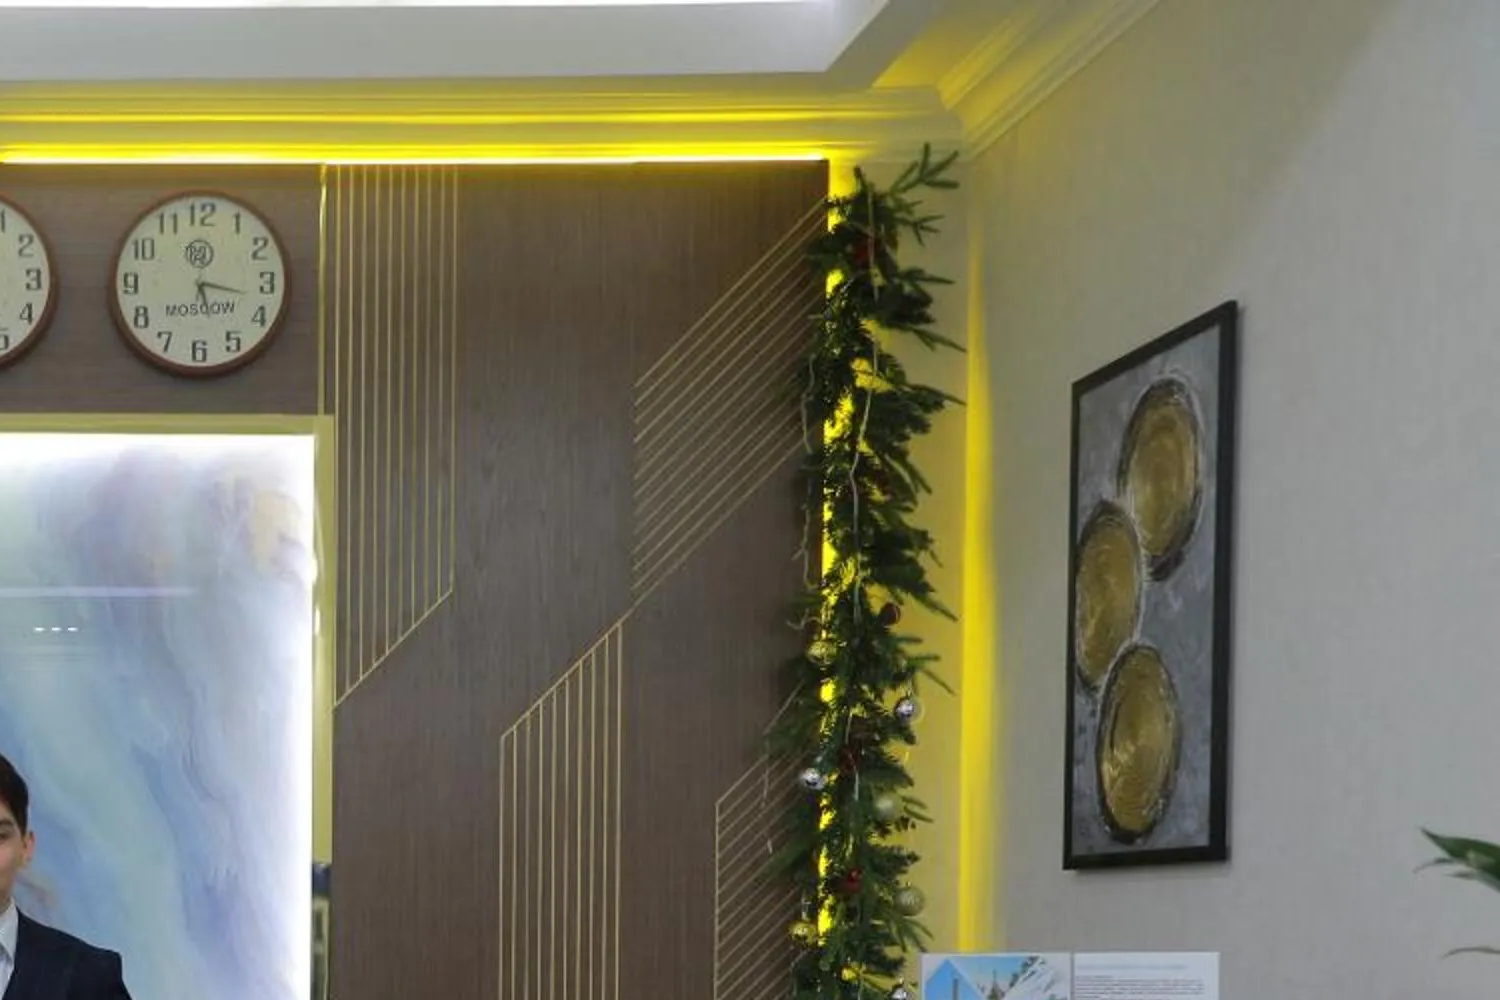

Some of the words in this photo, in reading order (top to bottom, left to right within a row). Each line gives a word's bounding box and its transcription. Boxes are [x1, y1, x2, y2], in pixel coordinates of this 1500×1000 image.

[0, 209, 6, 233] 1
[158, 212, 178, 234] 11
[190, 202, 216, 227] 12
[233, 212, 241, 234] 1
[18, 234, 34, 257] 2
[133, 238, 154, 260] 10
[252, 237, 268, 260] 2
[25, 268, 42, 291] 3
[123, 272, 139, 295] 9
[259, 271, 275, 294] 3
[19, 303, 34, 325] 4
[133, 306, 149, 328] 8
[252, 306, 266, 327] 4
[157, 331, 173, 352] 7
[191, 340, 207, 362] 6
[225, 330, 241, 352] 5
